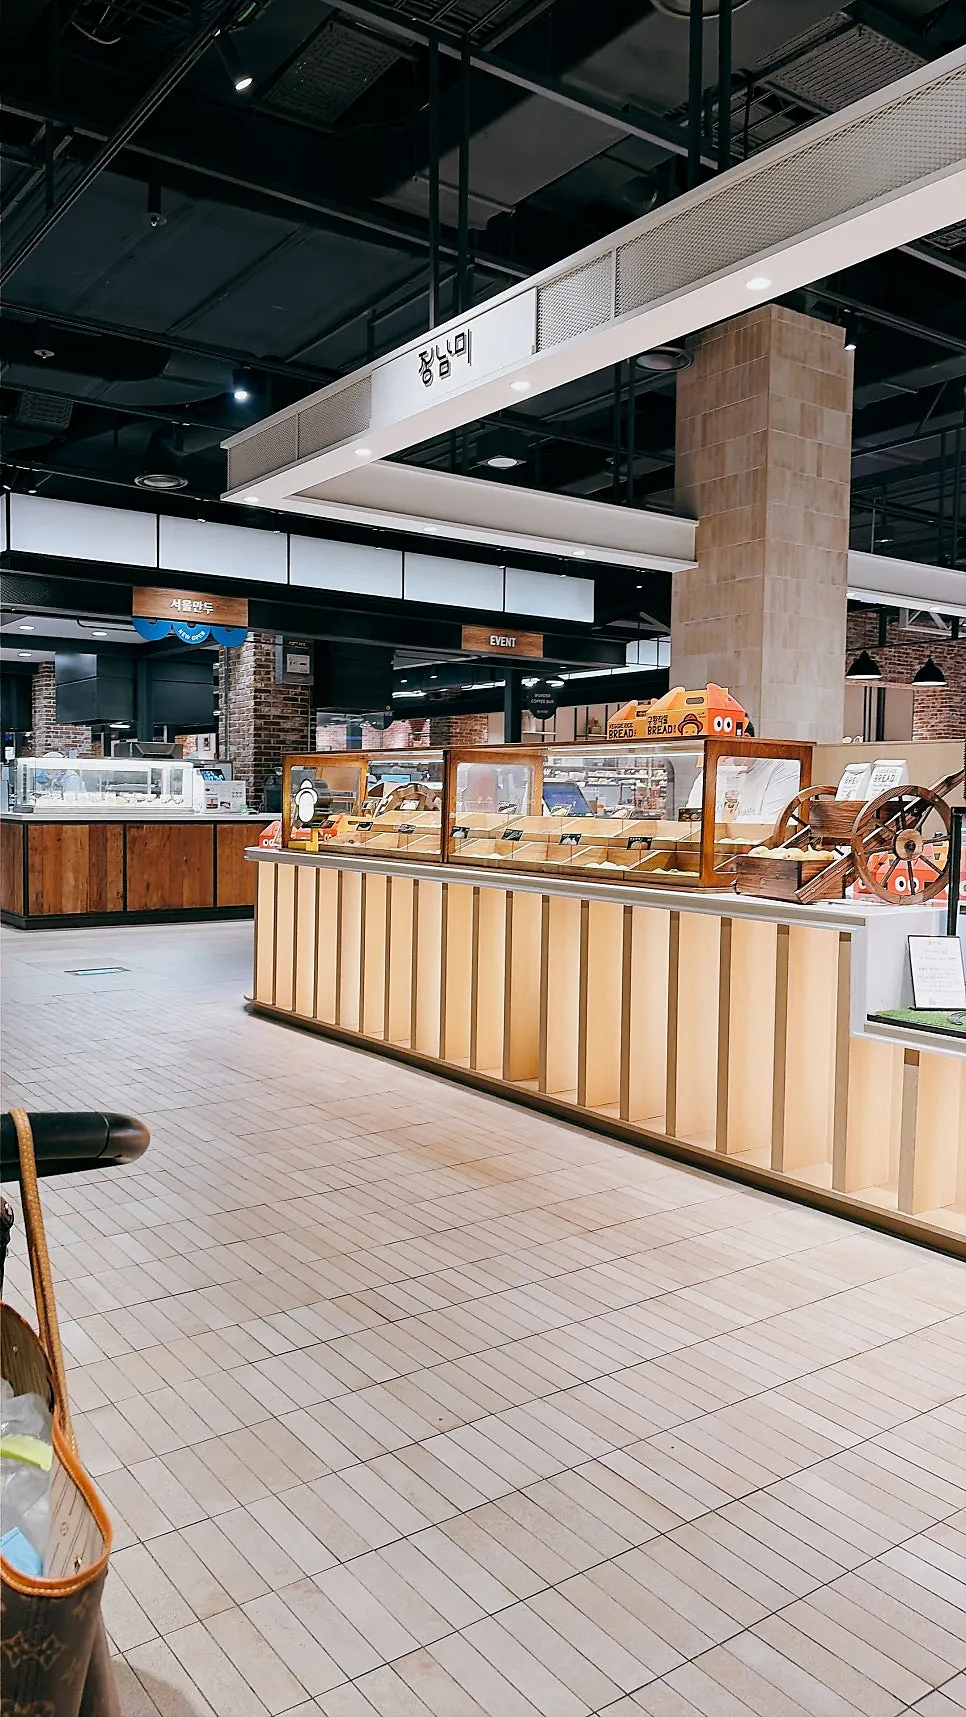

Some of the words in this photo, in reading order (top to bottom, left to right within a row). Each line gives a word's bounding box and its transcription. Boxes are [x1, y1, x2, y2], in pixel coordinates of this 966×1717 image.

[418, 328, 472, 387] 정남미
[170, 598, 214, 615] 서울만두
[178, 628, 191, 640] NEW
[191, 630, 206, 641] OPEN
[489, 635, 516, 648] EVENT
[608, 728, 634, 739] BREAD
[647, 725, 673, 735] BREAD
